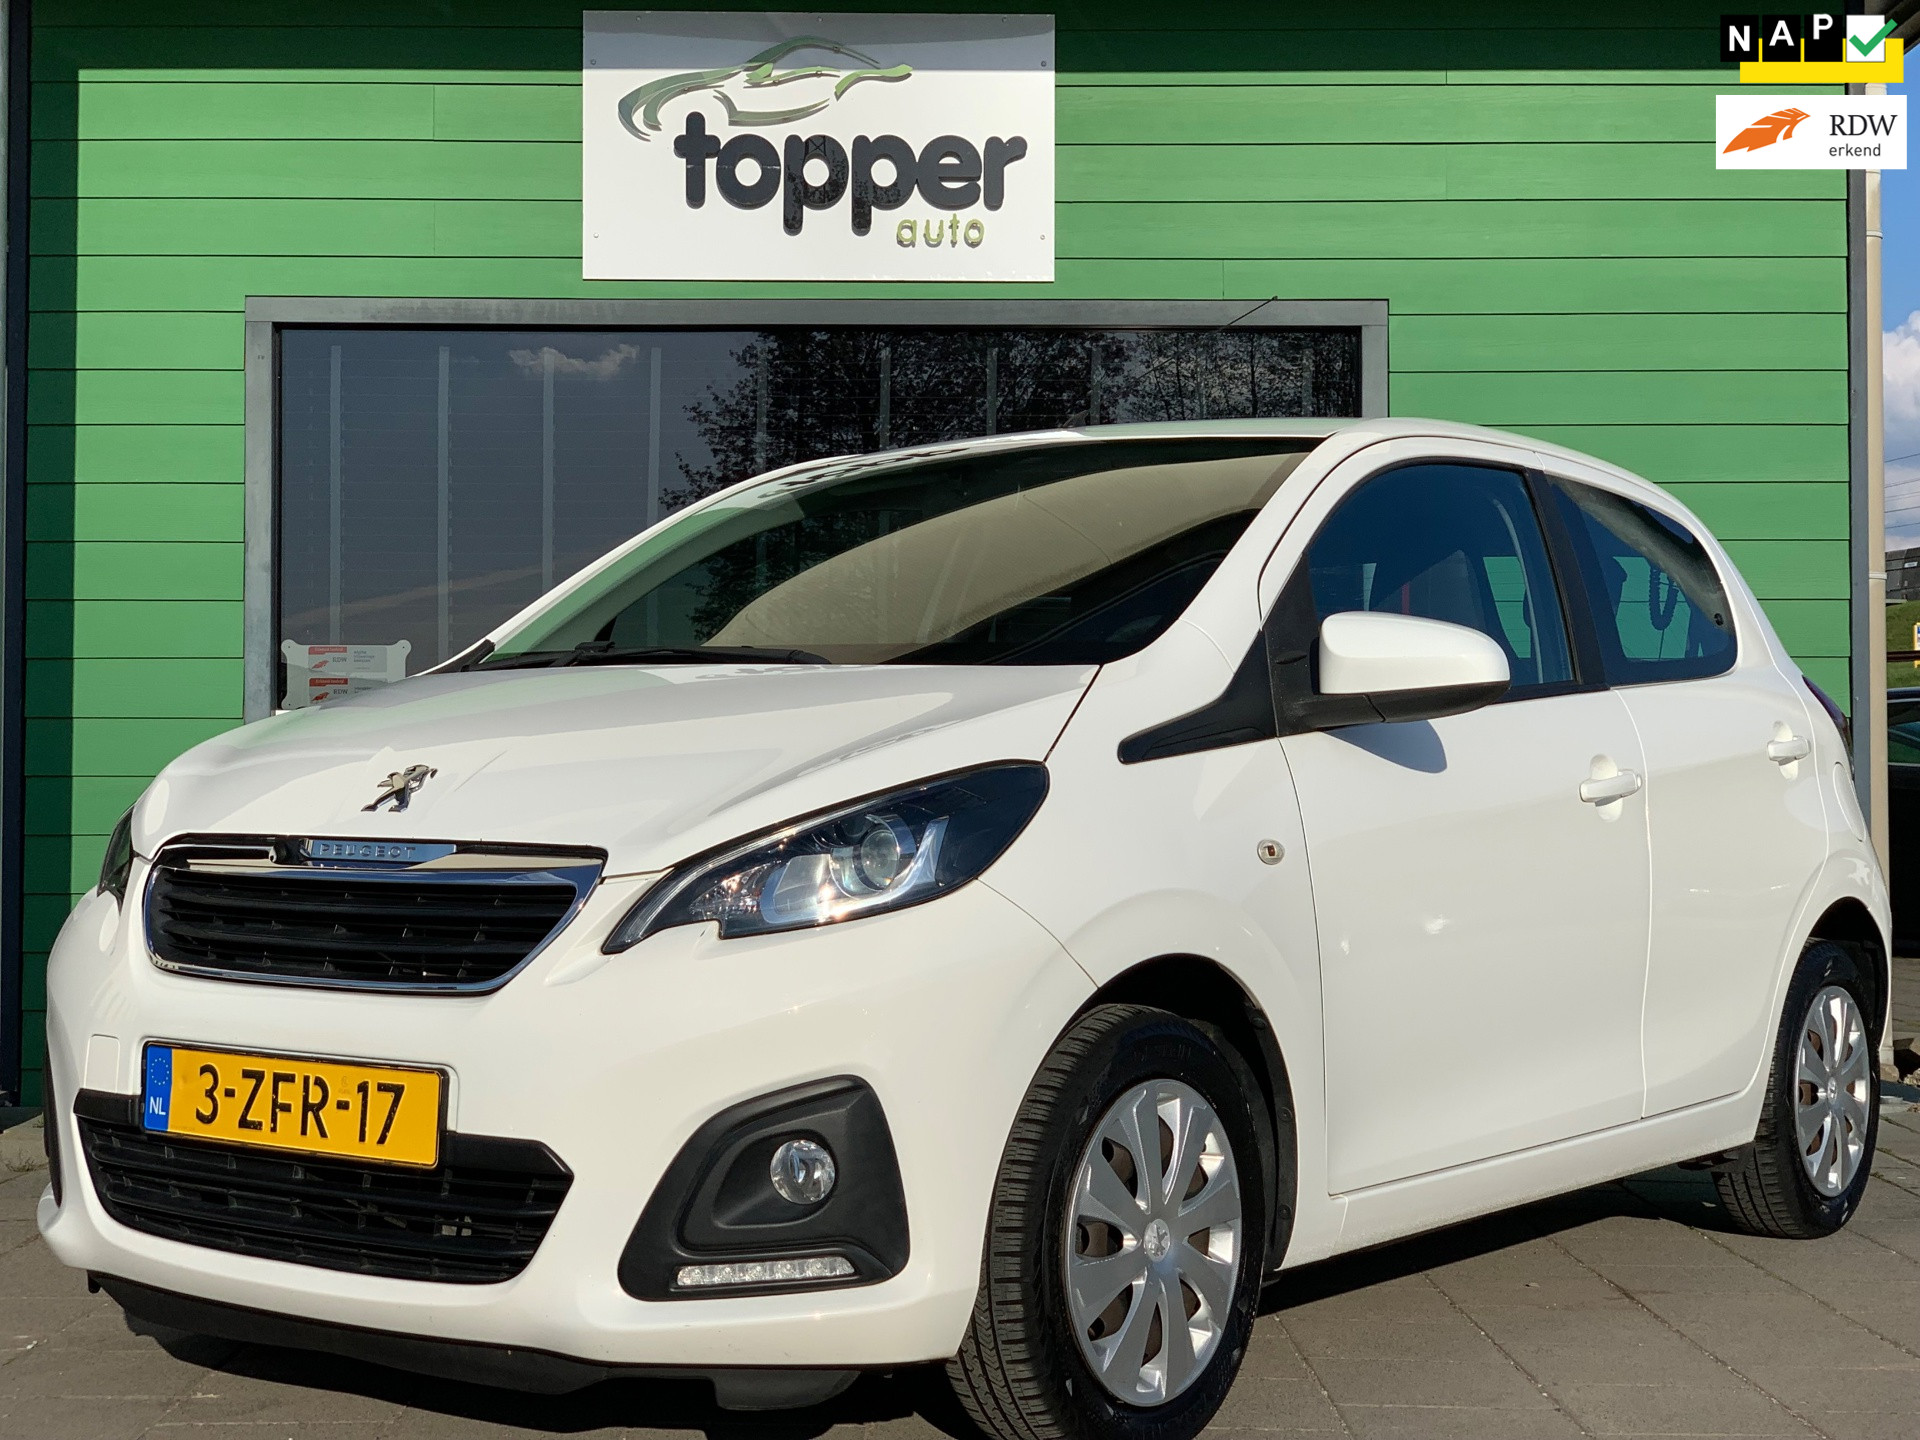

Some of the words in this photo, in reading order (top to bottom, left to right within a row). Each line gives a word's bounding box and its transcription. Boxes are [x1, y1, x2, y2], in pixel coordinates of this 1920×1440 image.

[673, 111, 1028, 236] topper
[896, 213, 985, 248] auto
[319, 843, 416, 859] PEUGEOT
[149, 1095, 167, 1116] NL
[195, 1063, 406, 1145] 3-ZFR-17
